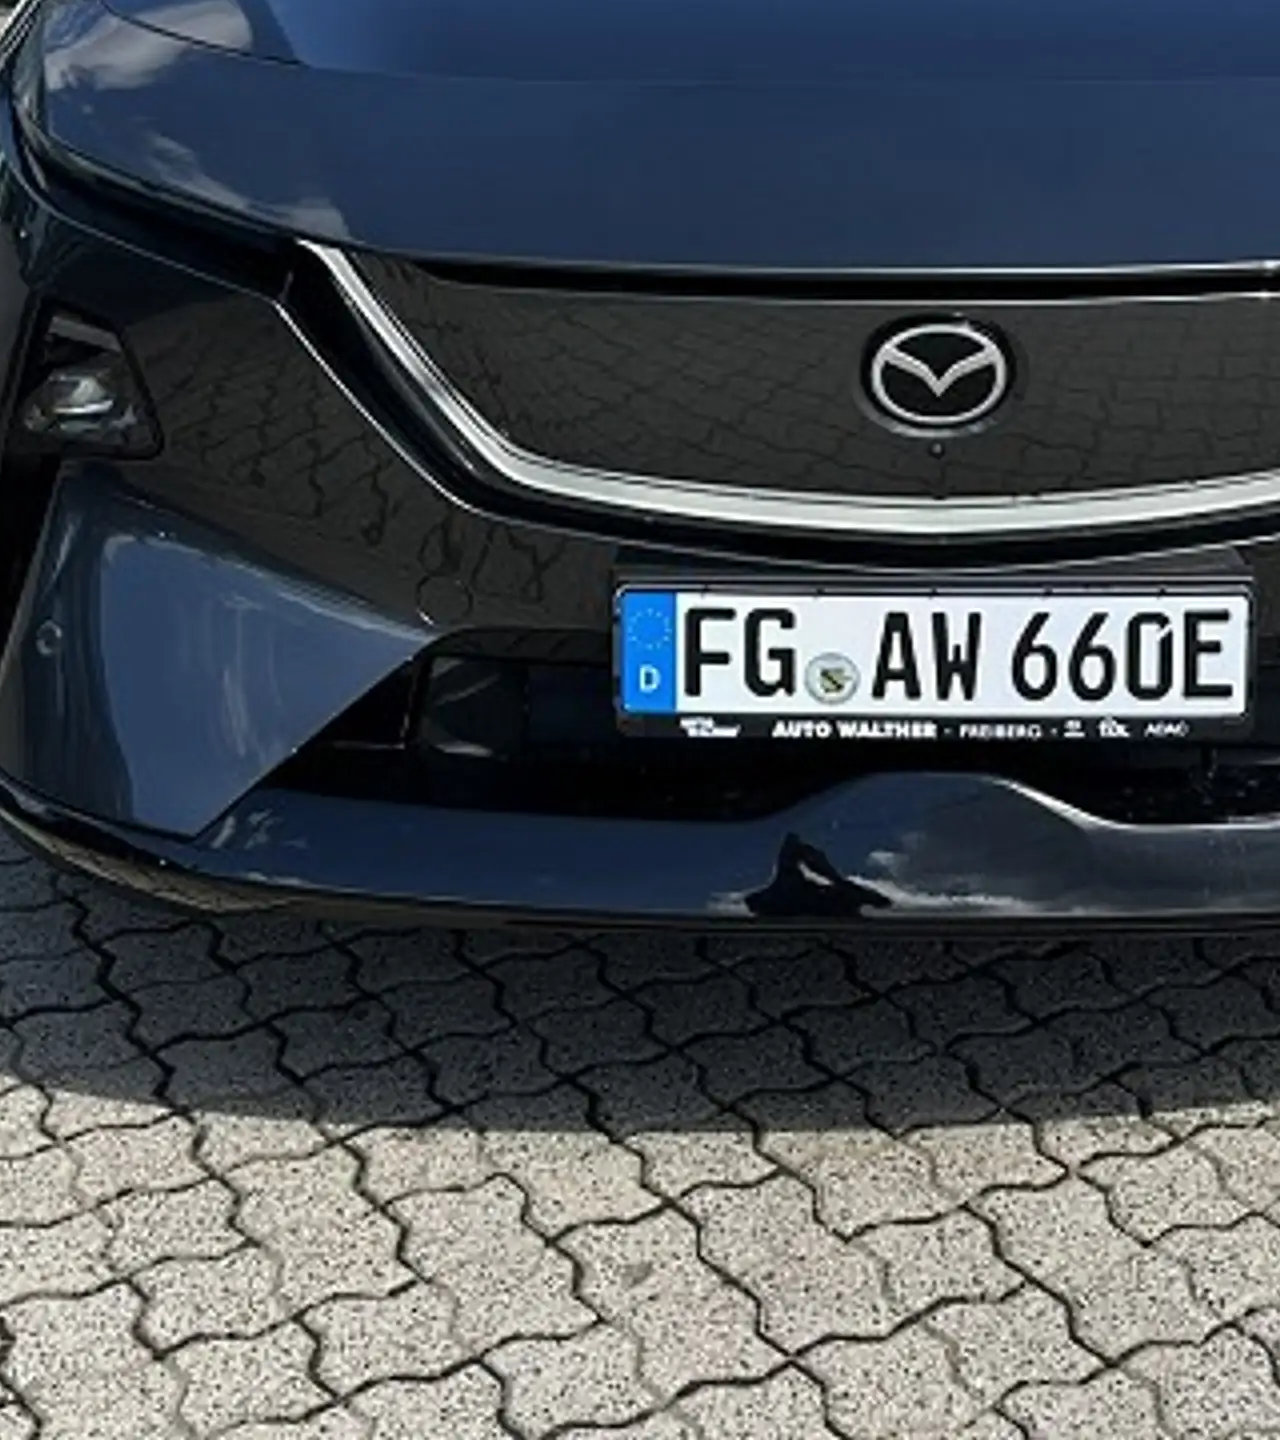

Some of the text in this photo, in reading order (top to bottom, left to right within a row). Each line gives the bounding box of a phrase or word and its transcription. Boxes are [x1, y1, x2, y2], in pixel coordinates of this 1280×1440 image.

[683, 607, 1234, 701] FG AW 660E
[638, 664, 662, 695] D
[771, 720, 830, 740] AUTO
[835, 720, 938, 740] WALTHER
